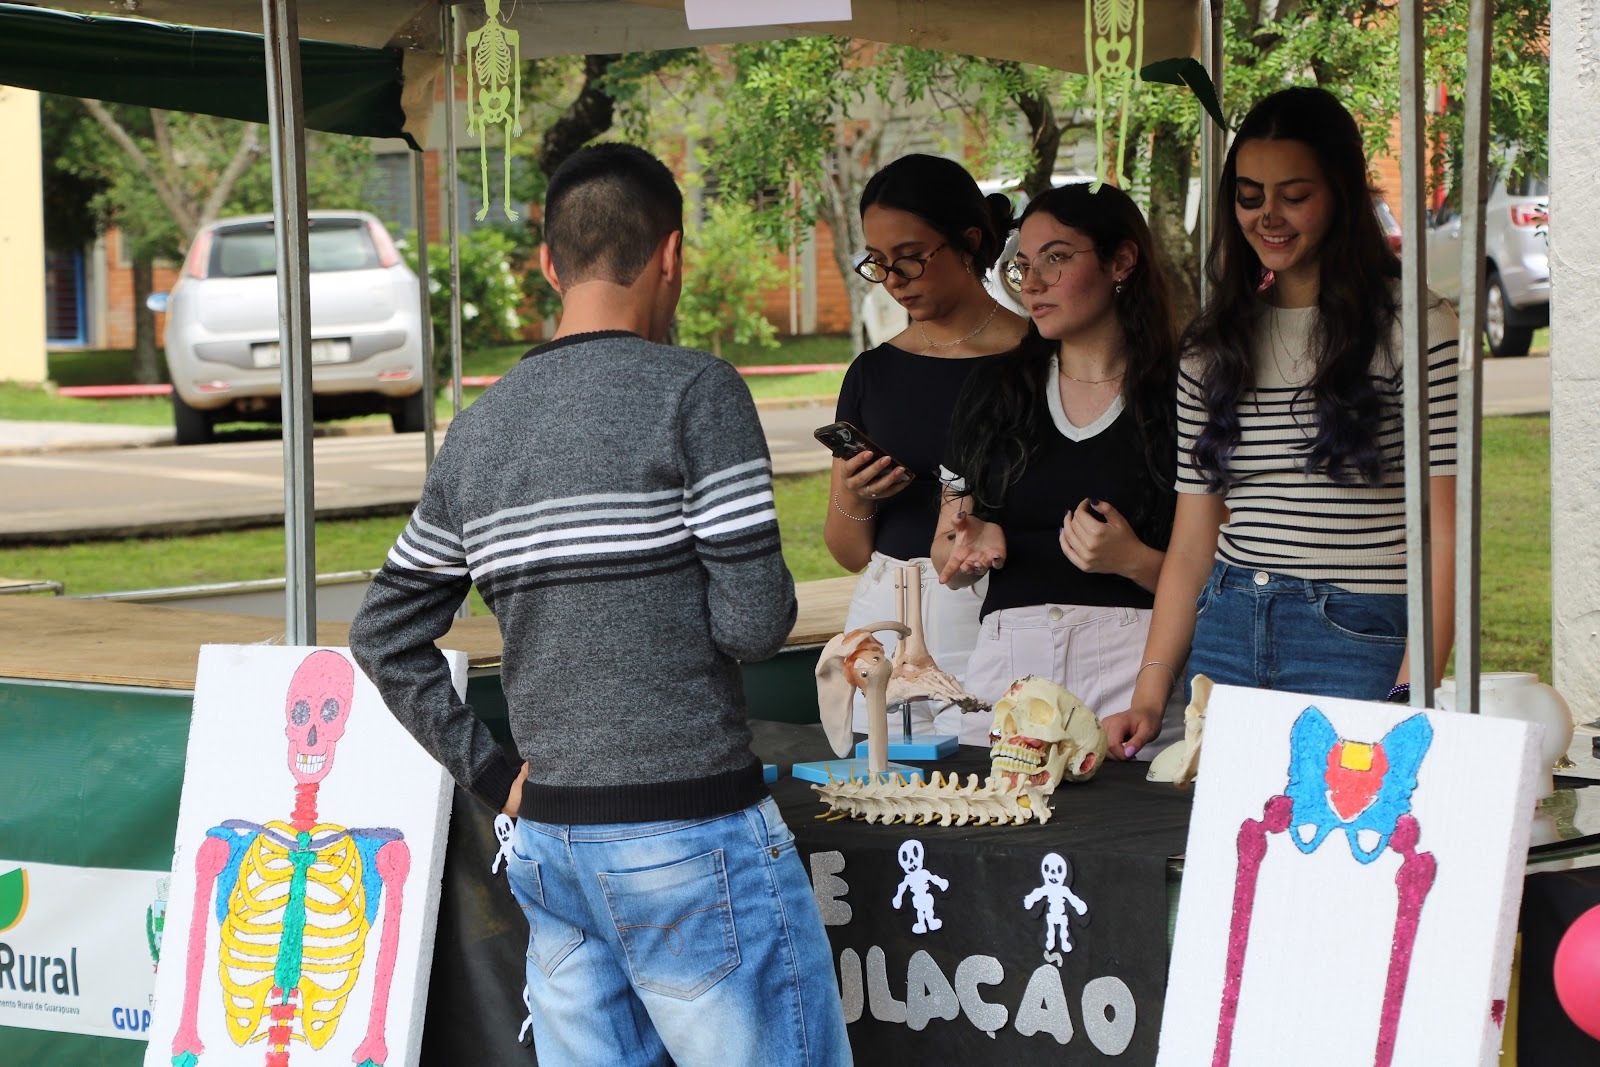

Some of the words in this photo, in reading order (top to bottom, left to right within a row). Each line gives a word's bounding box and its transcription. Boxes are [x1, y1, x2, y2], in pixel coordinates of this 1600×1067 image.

[0, 943, 79, 996] Rural
[17, 1001, 33, 1010] Rural
[35, 1003, 43, 1011] de
[44, 1003, 80, 1015] Guarapuava
